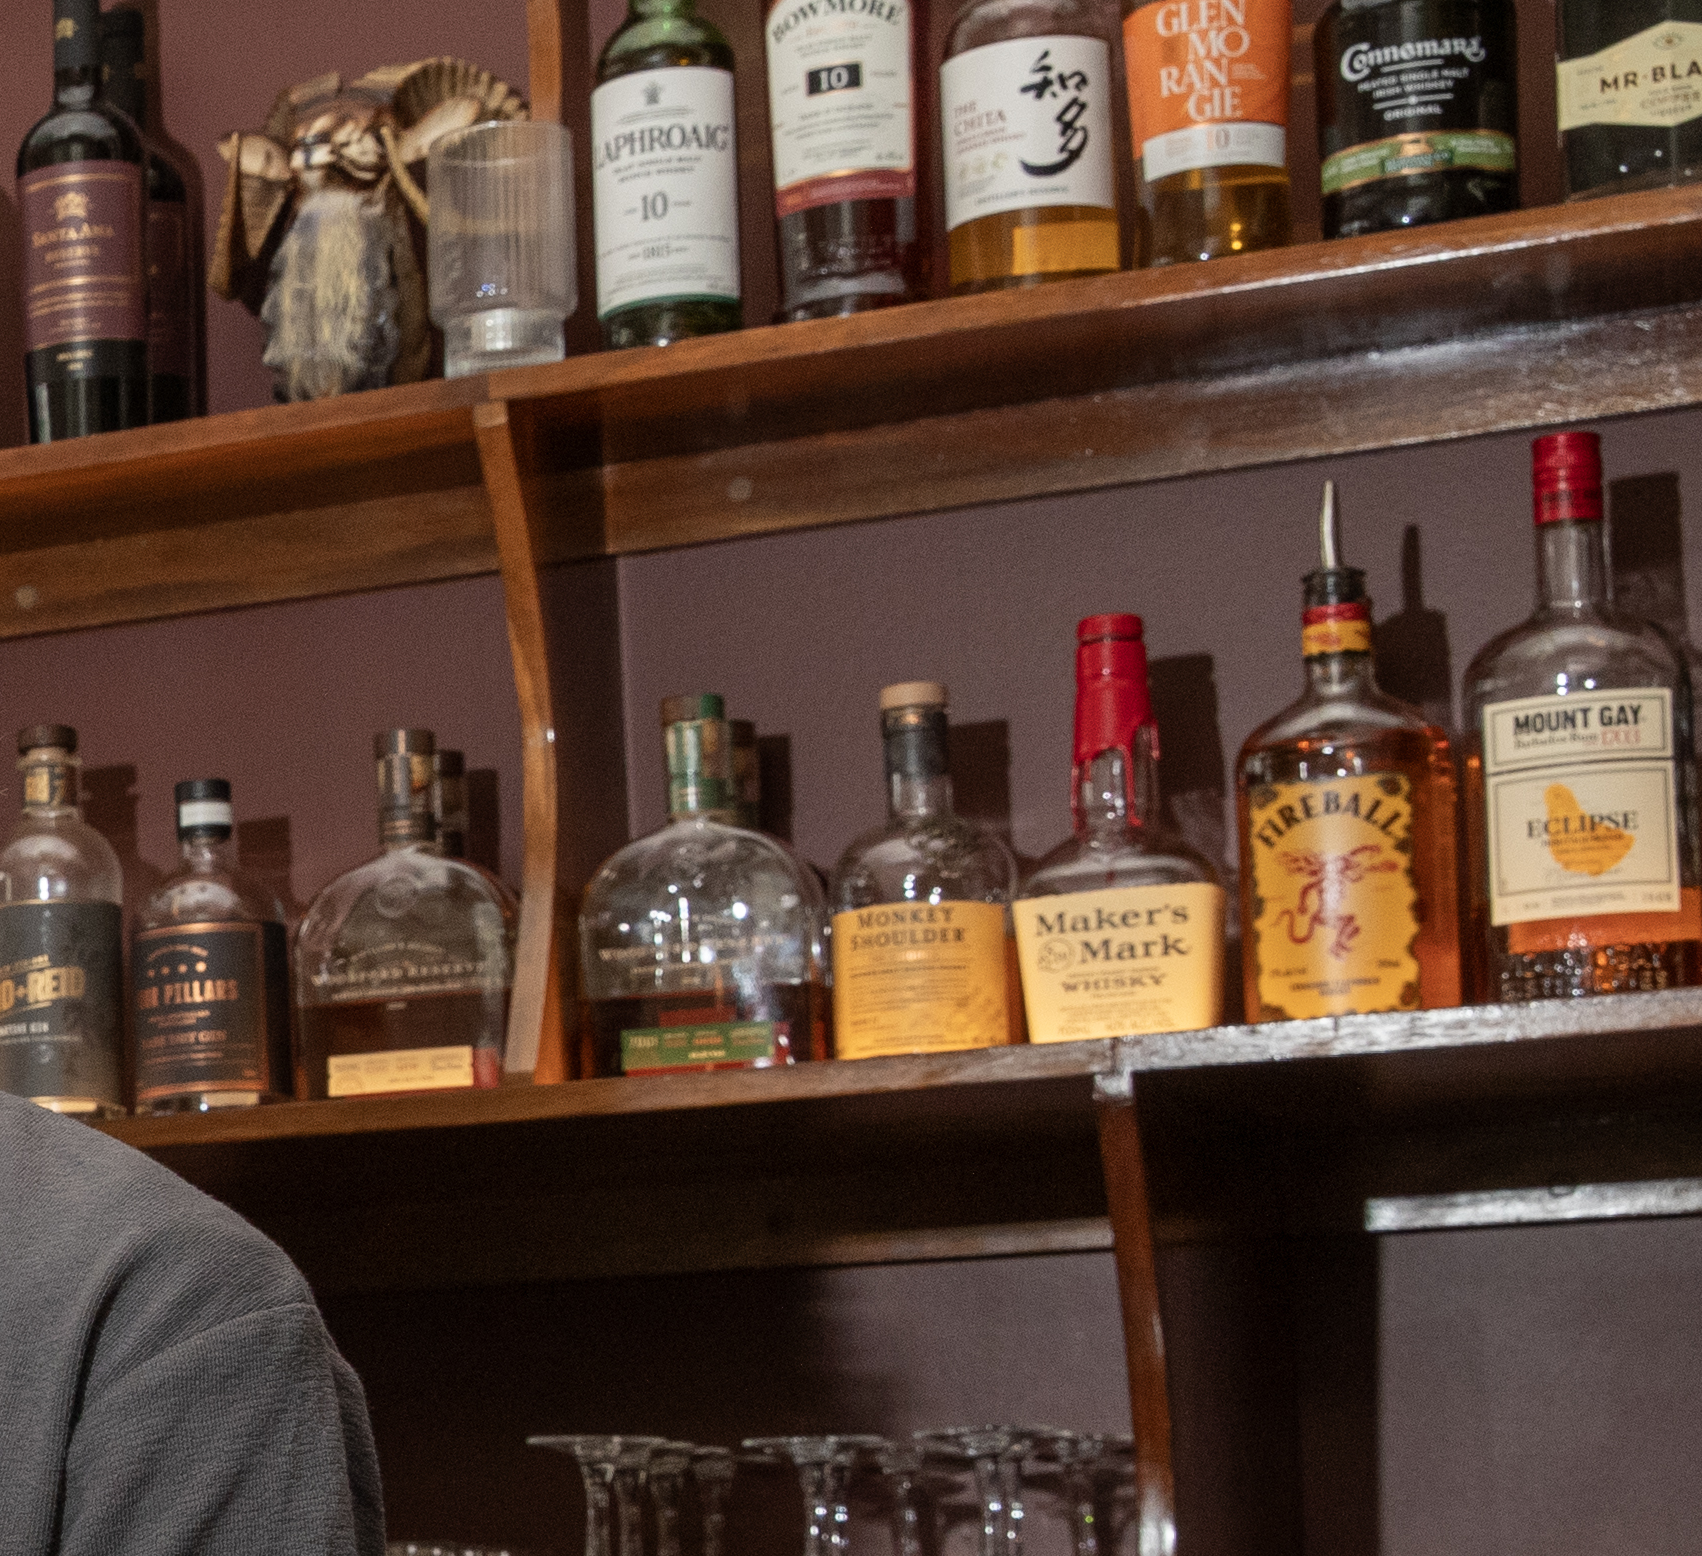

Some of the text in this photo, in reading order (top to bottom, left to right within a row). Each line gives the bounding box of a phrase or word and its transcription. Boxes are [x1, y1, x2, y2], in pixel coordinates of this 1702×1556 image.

[1155, 0, 1246, 37] GLEN
[1188, 25, 1251, 61] MO
[820, 66, 850, 91] 10
[1159, 57, 1229, 98] RAN
[1187, 86, 1243, 123] GIE
[640, 191, 670, 222] 10
[1513, 703, 1642, 737] MOUNT GAY
[1256, 790, 1401, 848] FIREBALL
[1526, 809, 1639, 839] ECLIPSE
[858, 906, 954, 930] MONKEY
[1035, 904, 1189, 937] Maker's
[851, 928, 965, 951] SHOULDER
[1080, 933, 1193, 965] Mark
